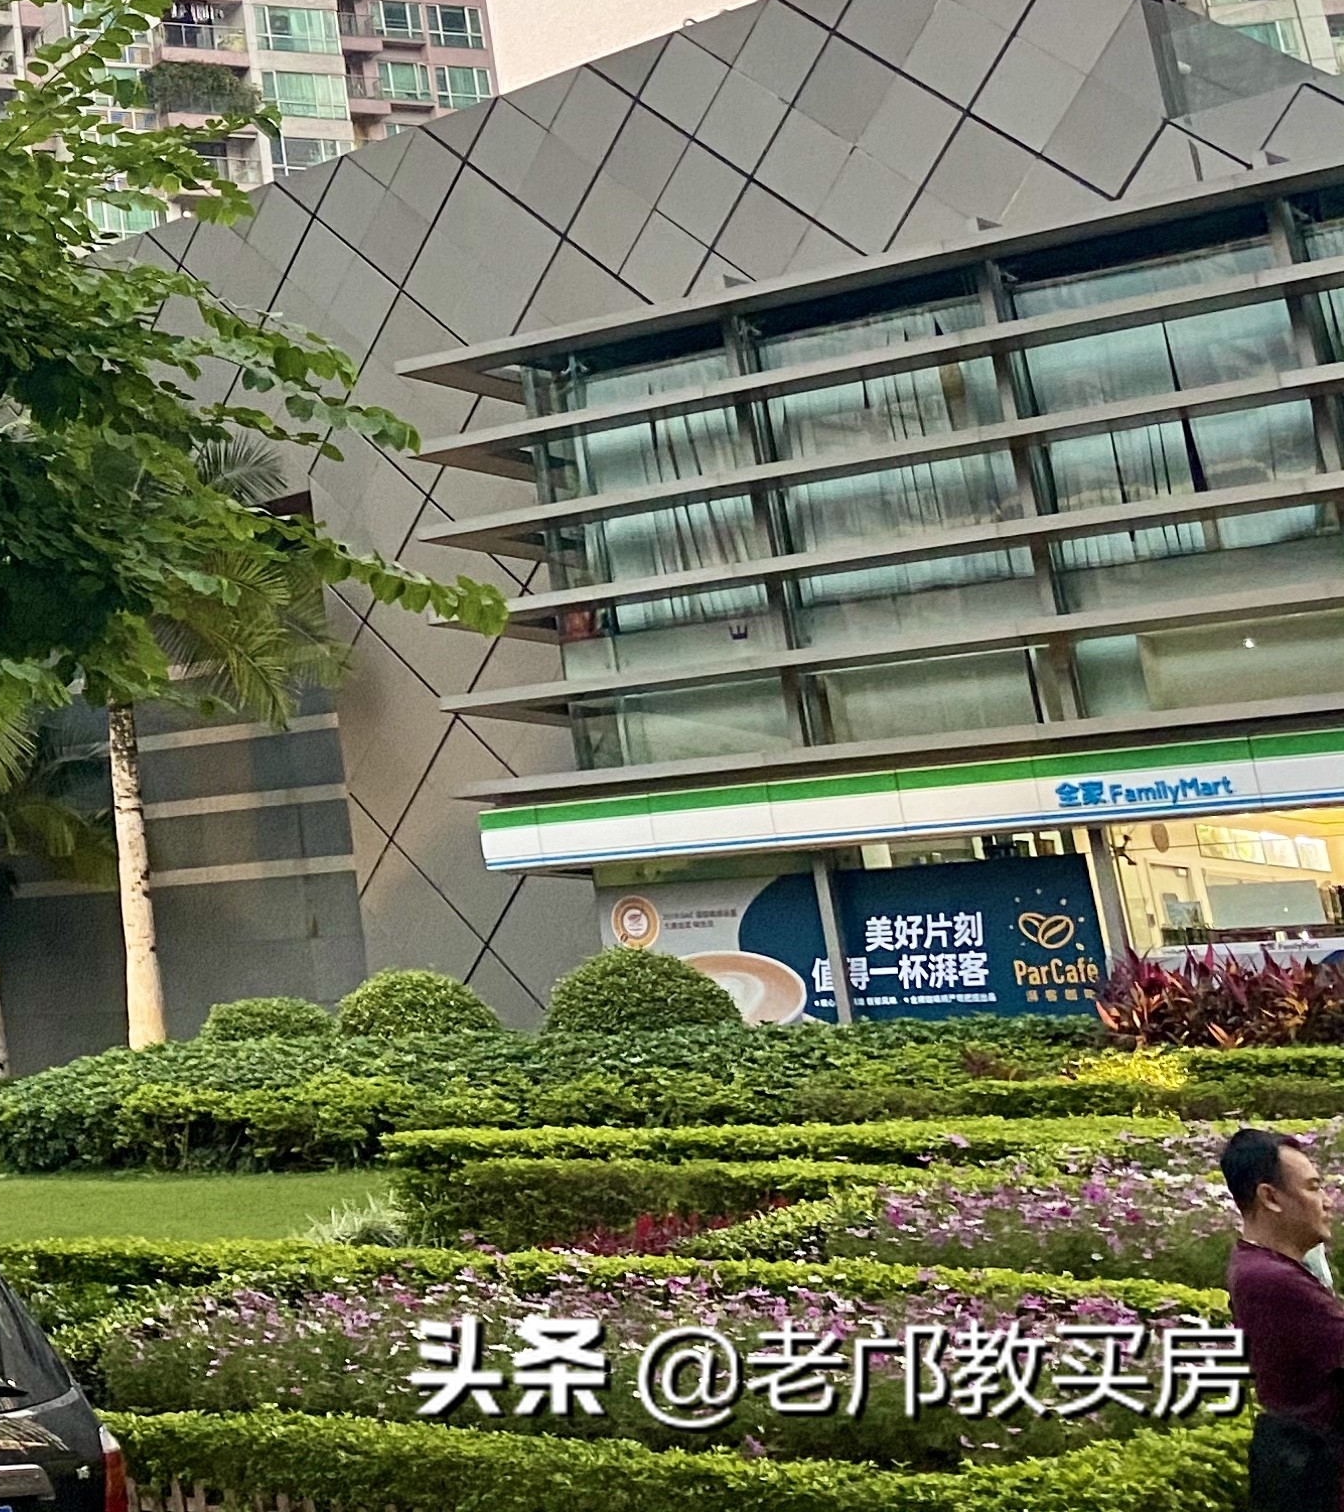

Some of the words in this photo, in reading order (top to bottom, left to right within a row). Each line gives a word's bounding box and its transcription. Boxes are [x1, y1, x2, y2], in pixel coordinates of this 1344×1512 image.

[1055, 780, 1104, 807] 全家
[1109, 776, 1234, 804] FamilyMart
[865, 911, 983, 952] 美好片刻
